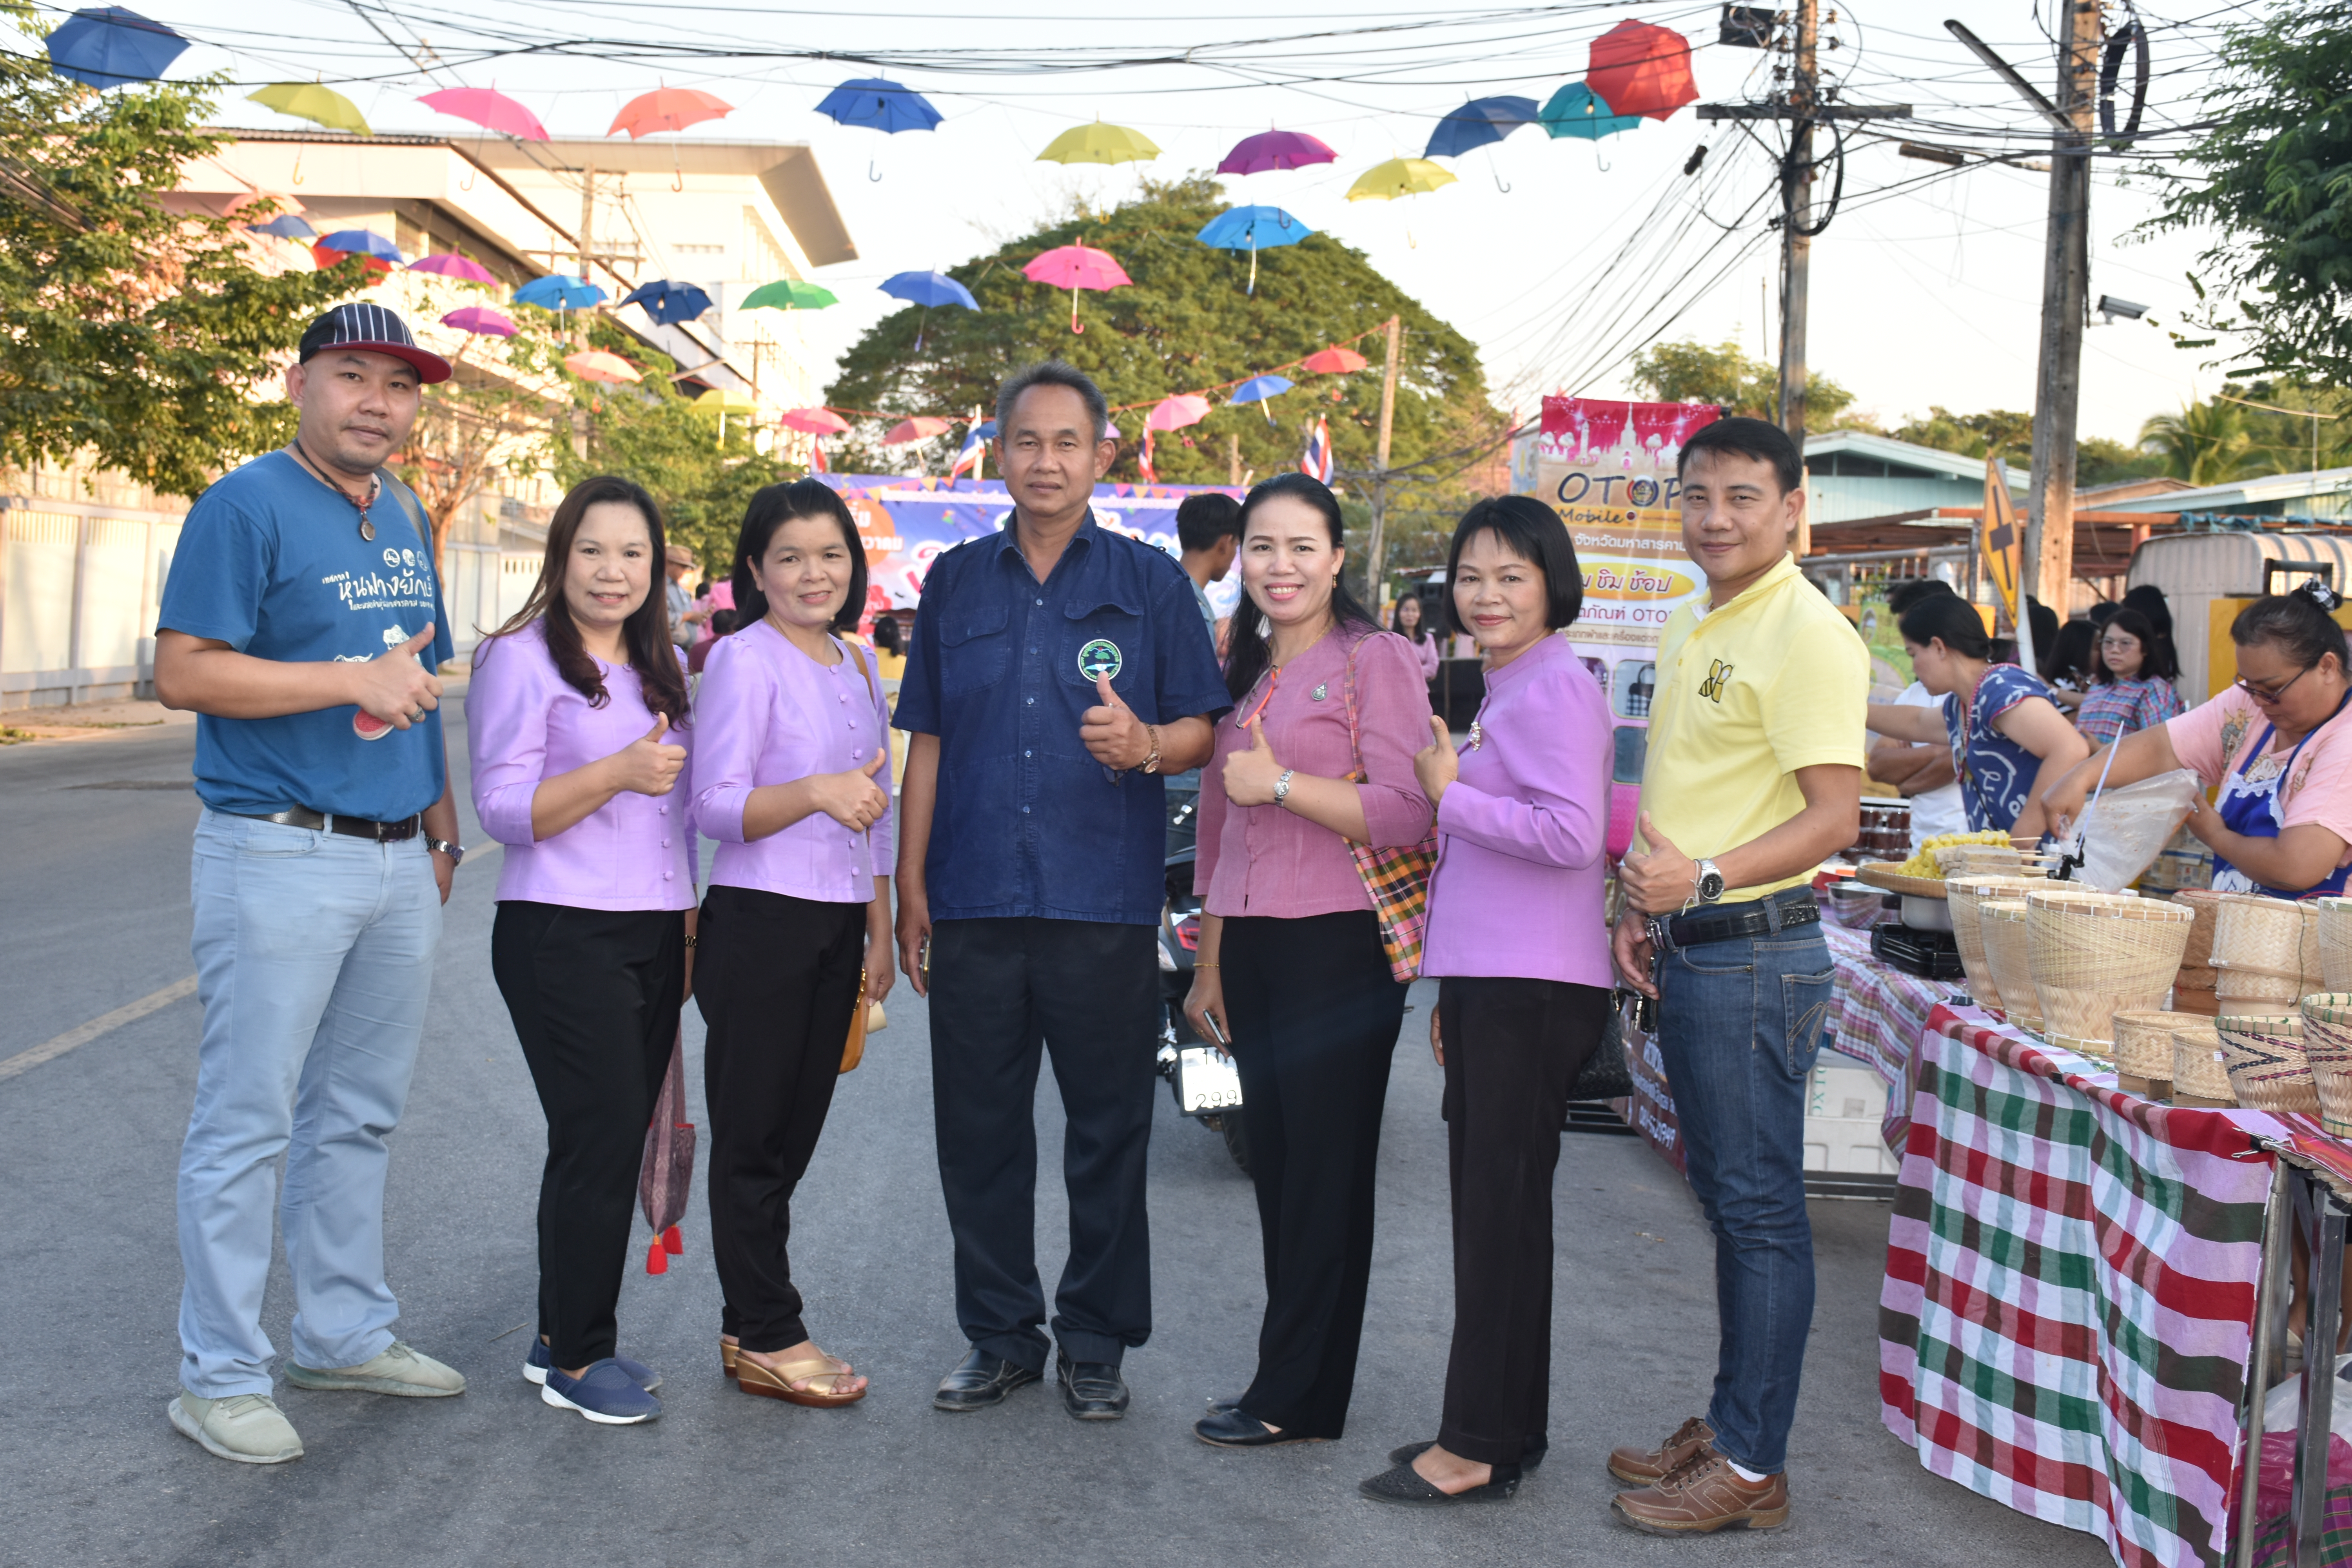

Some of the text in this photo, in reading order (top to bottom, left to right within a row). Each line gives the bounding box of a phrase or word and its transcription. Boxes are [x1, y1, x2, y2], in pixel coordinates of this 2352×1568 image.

[1559, 508, 1624, 523] Mobile
[338, 568, 432, 610] หุ่นฟางยักษ์
[1597, 569, 1624, 588] ชิม
[1630, 570, 1672, 592] ช้อป
[1633, 608, 1672, 622] OTO
